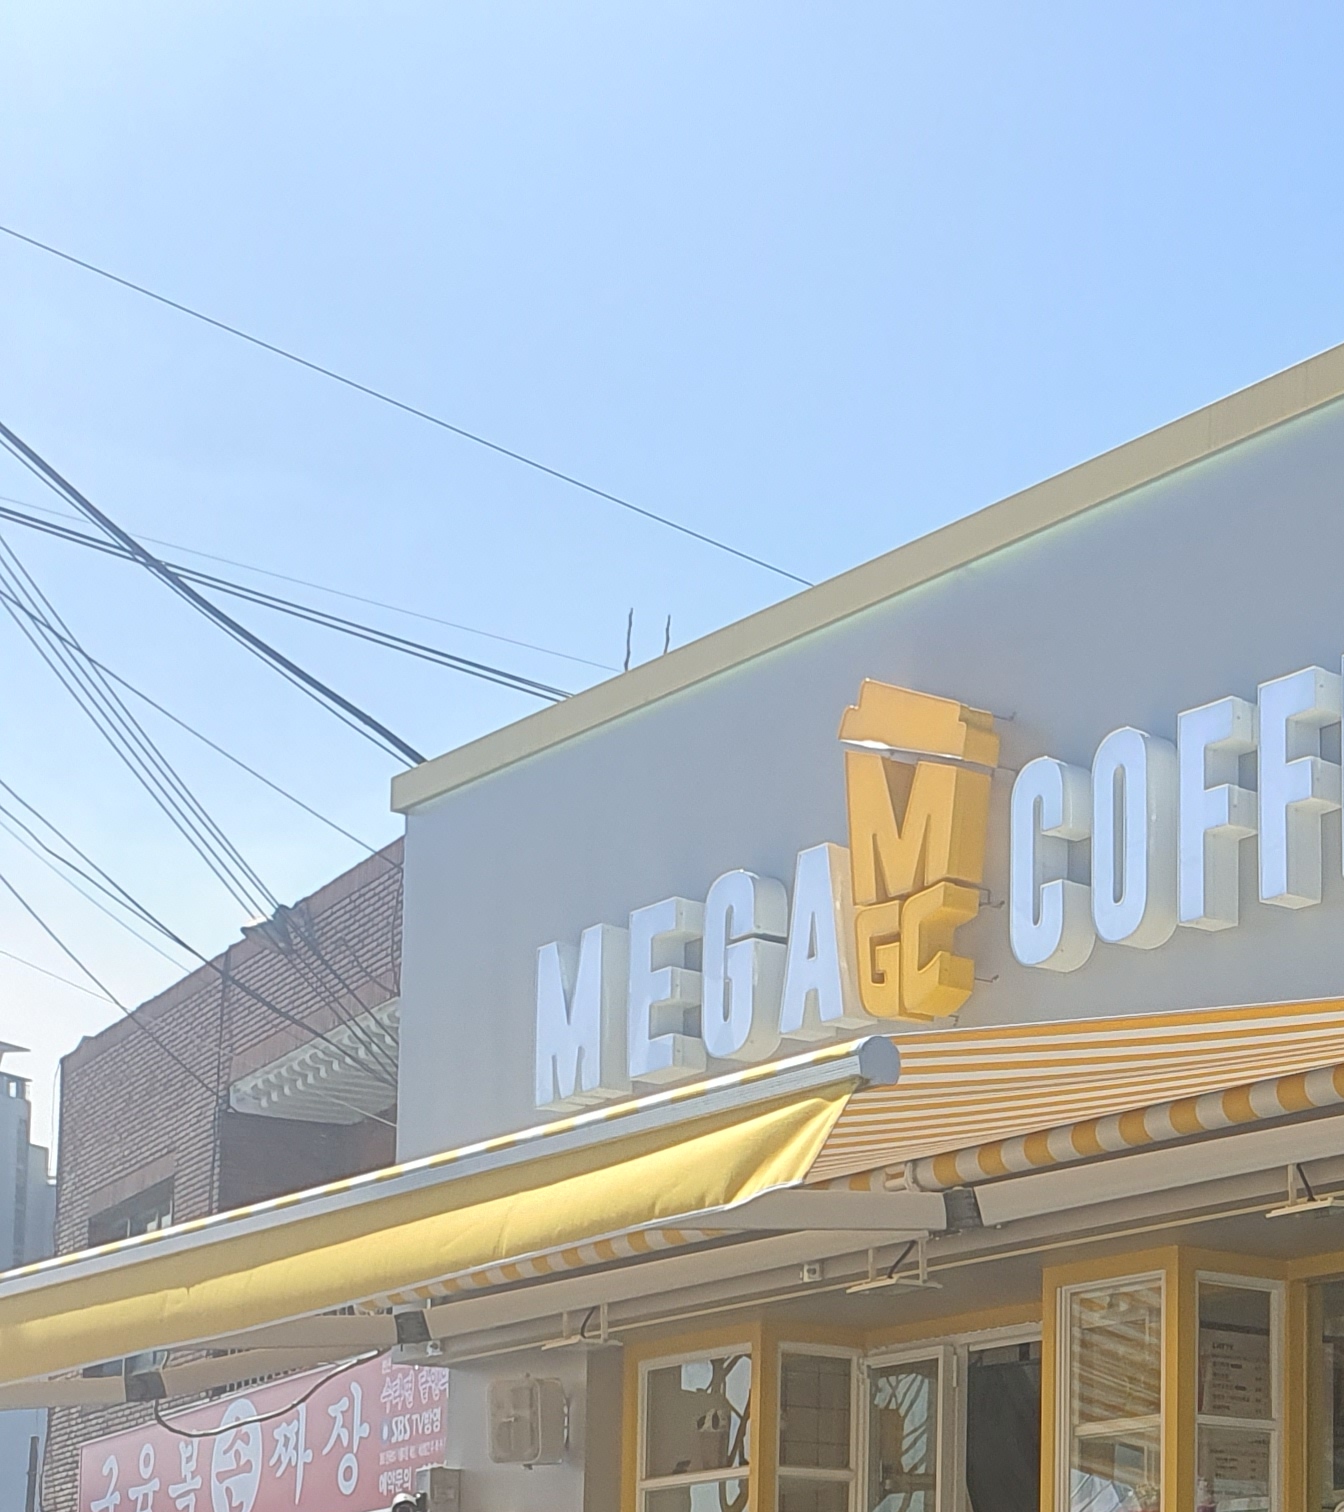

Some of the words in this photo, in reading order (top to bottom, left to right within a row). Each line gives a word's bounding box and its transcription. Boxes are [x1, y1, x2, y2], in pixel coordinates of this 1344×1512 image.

[535, 843, 862, 1110] MEGA
[391, 1414, 411, 1443] SBS
[379, 1467, 412, 1496] 예약문의
